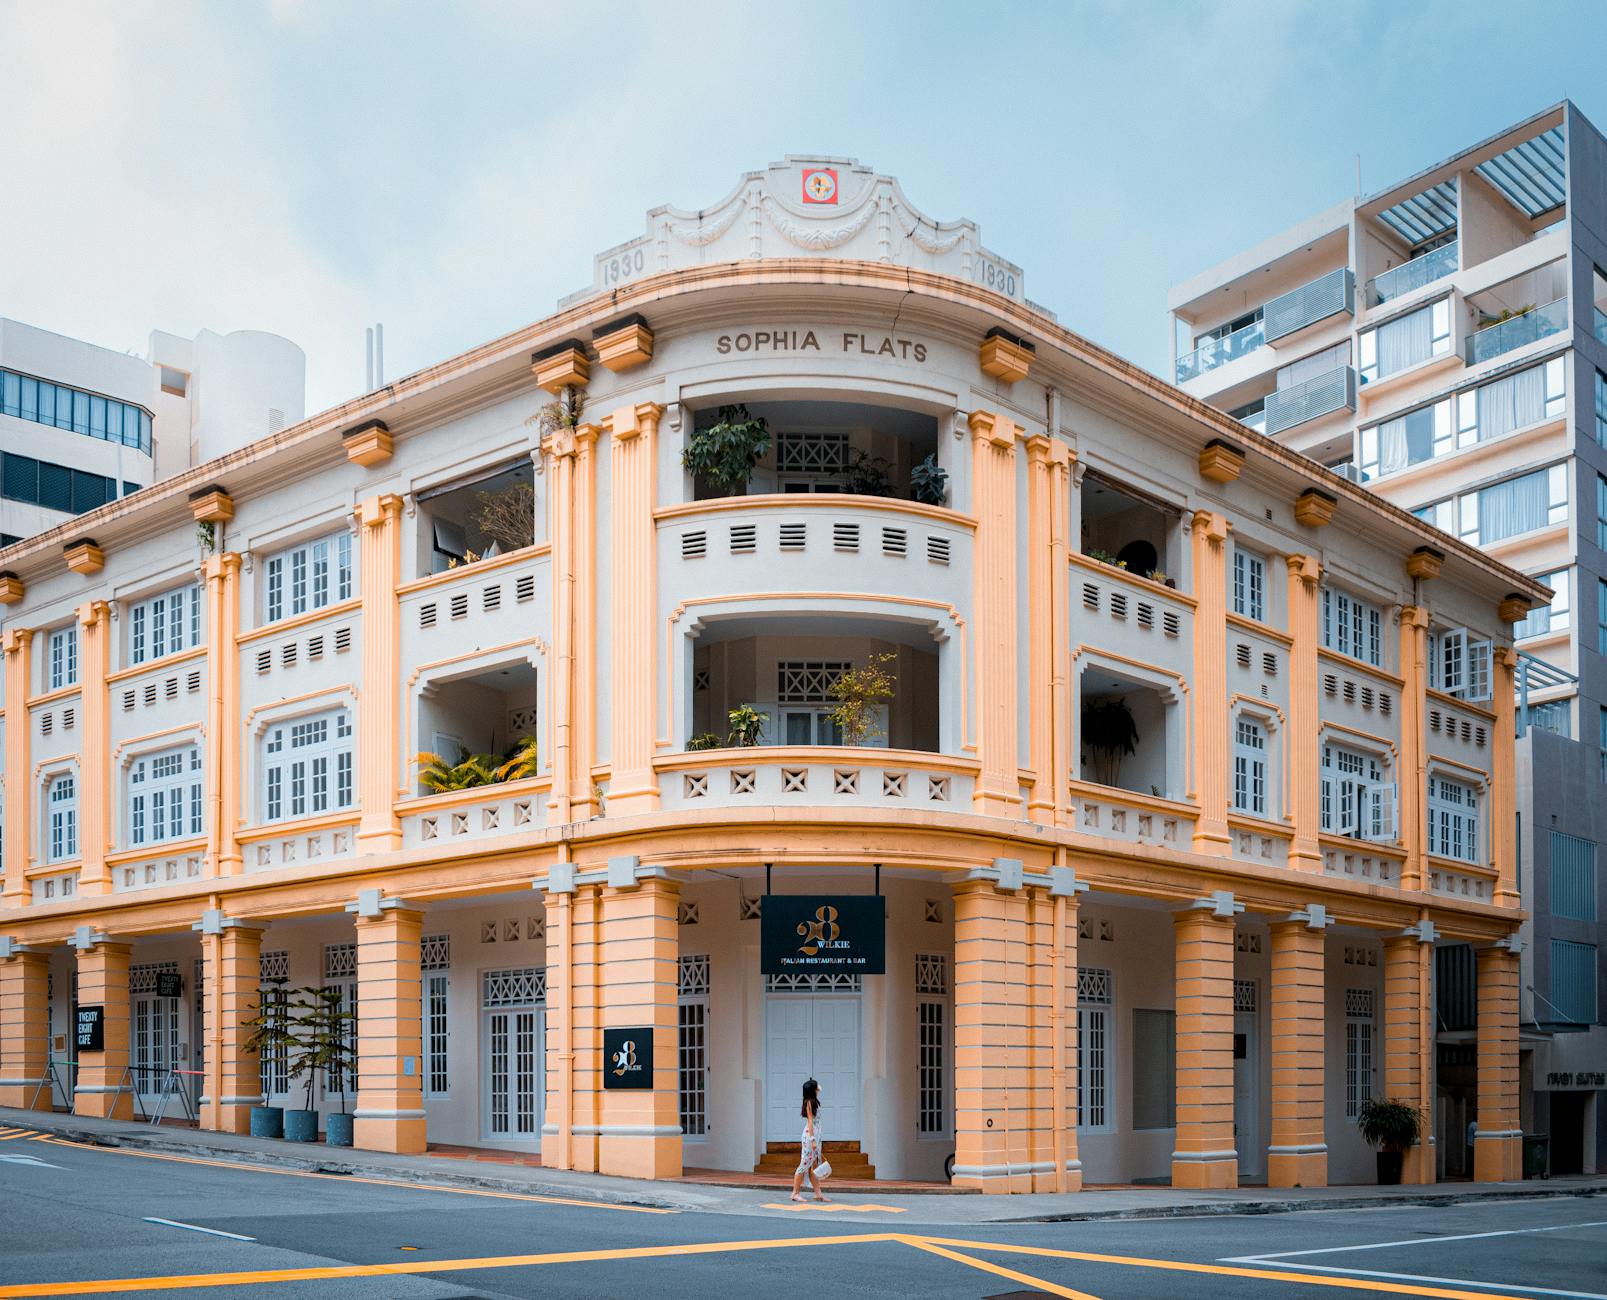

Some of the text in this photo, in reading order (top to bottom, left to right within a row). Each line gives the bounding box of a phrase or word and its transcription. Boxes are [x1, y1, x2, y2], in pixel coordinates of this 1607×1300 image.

[603, 248, 645, 283] 1930
[980, 258, 1017, 297] 1930
[716, 330, 928, 363] SOPHIA FLATS
[796, 905, 841, 956] 28
[817, 940, 851, 949] WILKIE
[780, 957, 805, 965] ITALIAN
[78, 1011, 98, 1023] TWENTY
[78, 1022, 93, 1034] EIGHT
[78, 1034, 92, 1045] CAFE
